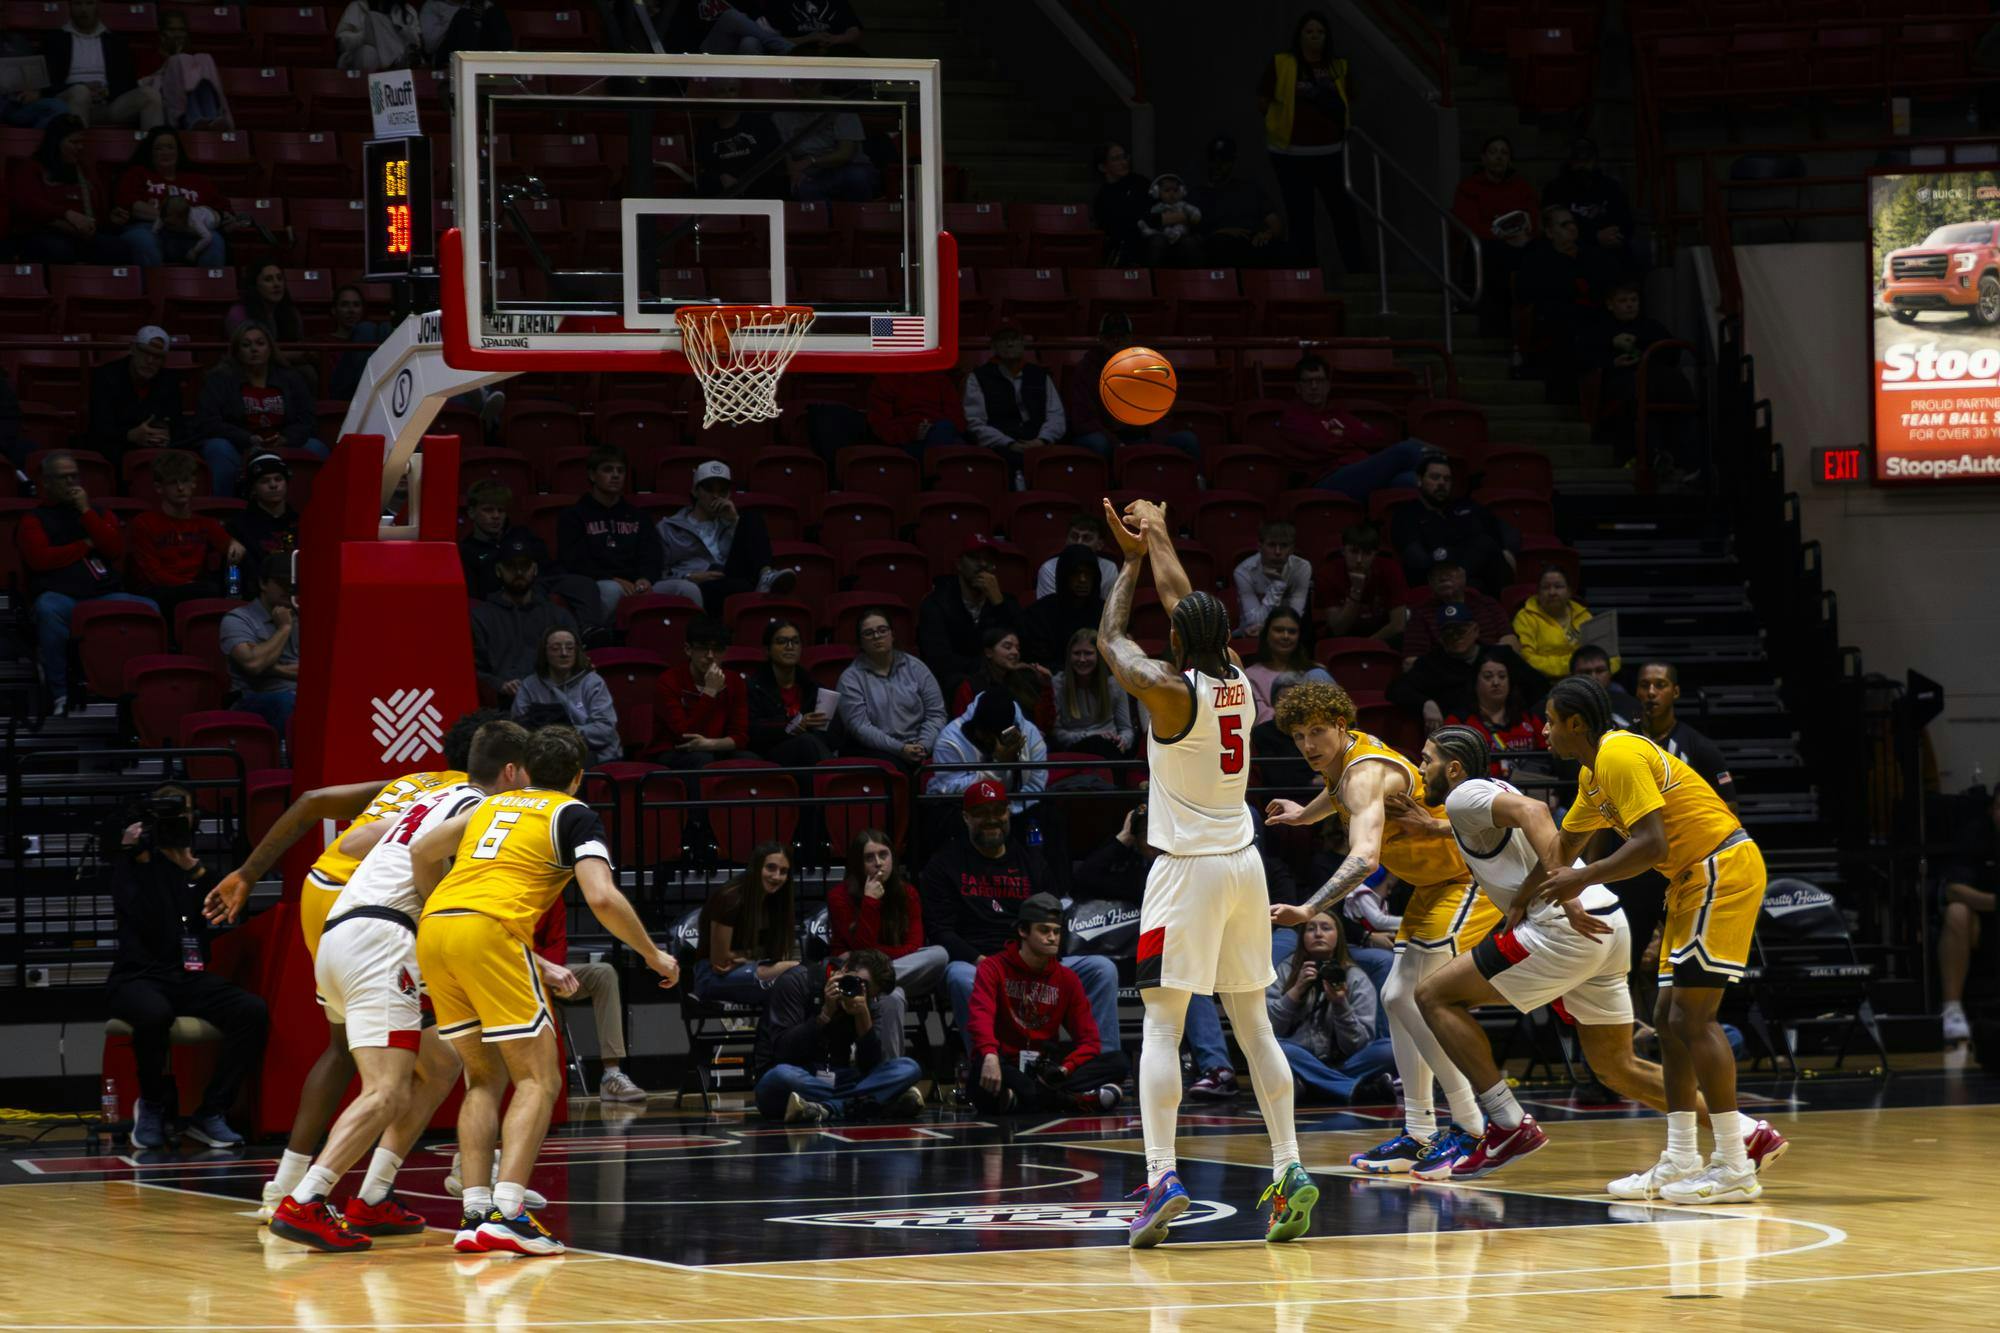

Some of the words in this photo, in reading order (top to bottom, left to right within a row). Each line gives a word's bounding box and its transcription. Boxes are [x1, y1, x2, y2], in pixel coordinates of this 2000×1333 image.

[384, 80, 412, 107] Ruoff
[1932, 189, 1963, 200] BUICK
[387, 206, 409, 252] 30
[518, 314, 555, 334] ARENA
[480, 337, 529, 349] SPALDING
[1881, 342, 2000, 386] Stoo
[1910, 399, 1953, 411] PROUD
[1956, 397, 2000, 410] PARTNE
[1901, 413, 1946, 427] TEAM
[1949, 411, 1988, 426] BALL
[1909, 428, 1934, 441] FOR
[1936, 427, 1970, 440] OVER
[1974, 427, 1988, 439] 30
[1824, 450, 1860, 480] EXIT
[1217, 714, 1244, 775] 5
[471, 810, 522, 859] 6
[1067, 913, 1106, 933] Varsity
[1107, 907, 1140, 926] Hous
